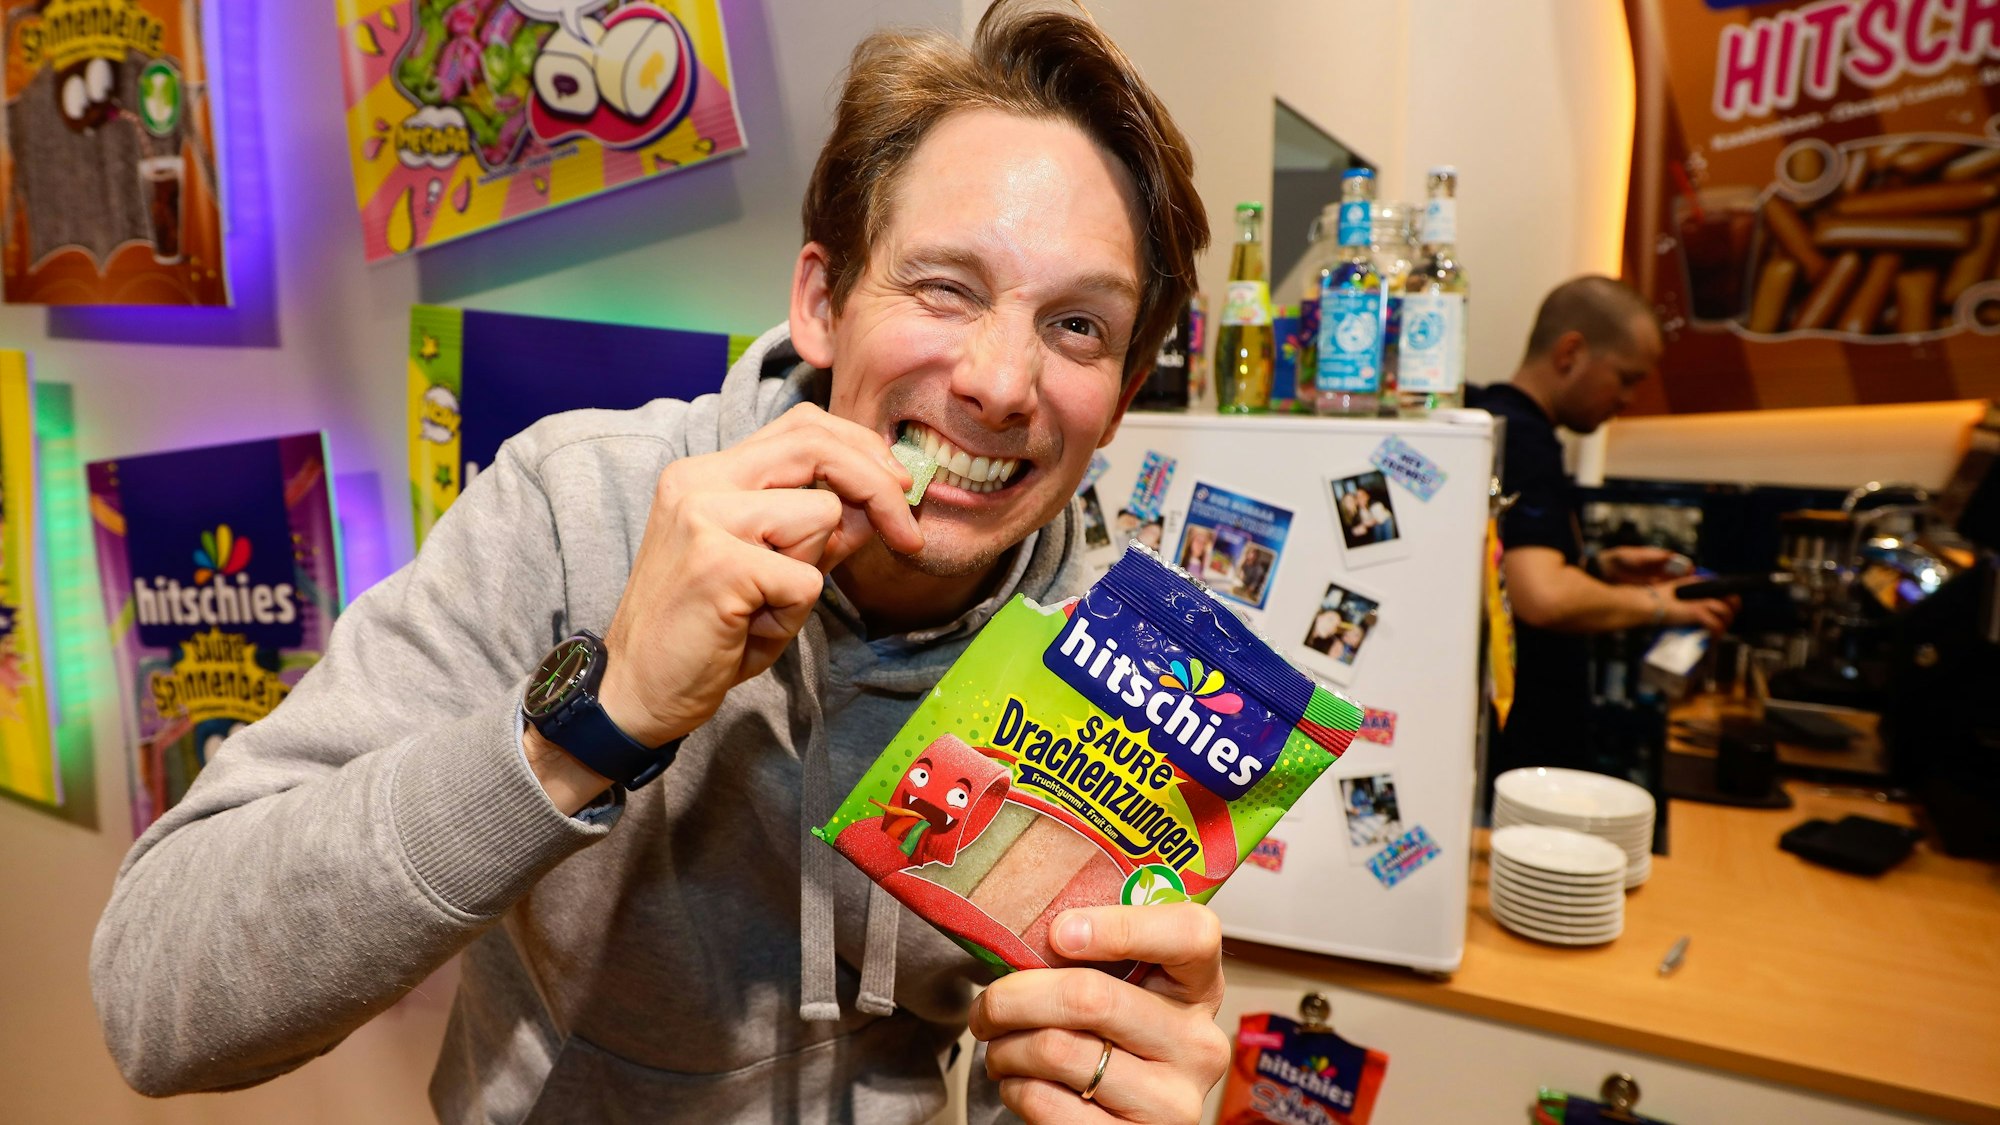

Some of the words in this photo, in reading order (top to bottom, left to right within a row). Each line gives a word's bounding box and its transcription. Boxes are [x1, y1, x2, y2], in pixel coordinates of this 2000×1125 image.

[134, 574, 296, 626] hitschies
[1059, 617, 1263, 786] hitschies
[992, 697, 1200, 872] Drachenzungen
[1031, 772, 1085, 808] Fruchtgummi
[1086, 809, 1106, 828] Fruit
[1104, 822, 1119, 840] Gum
[1257, 1052, 1354, 1108] hitschies
